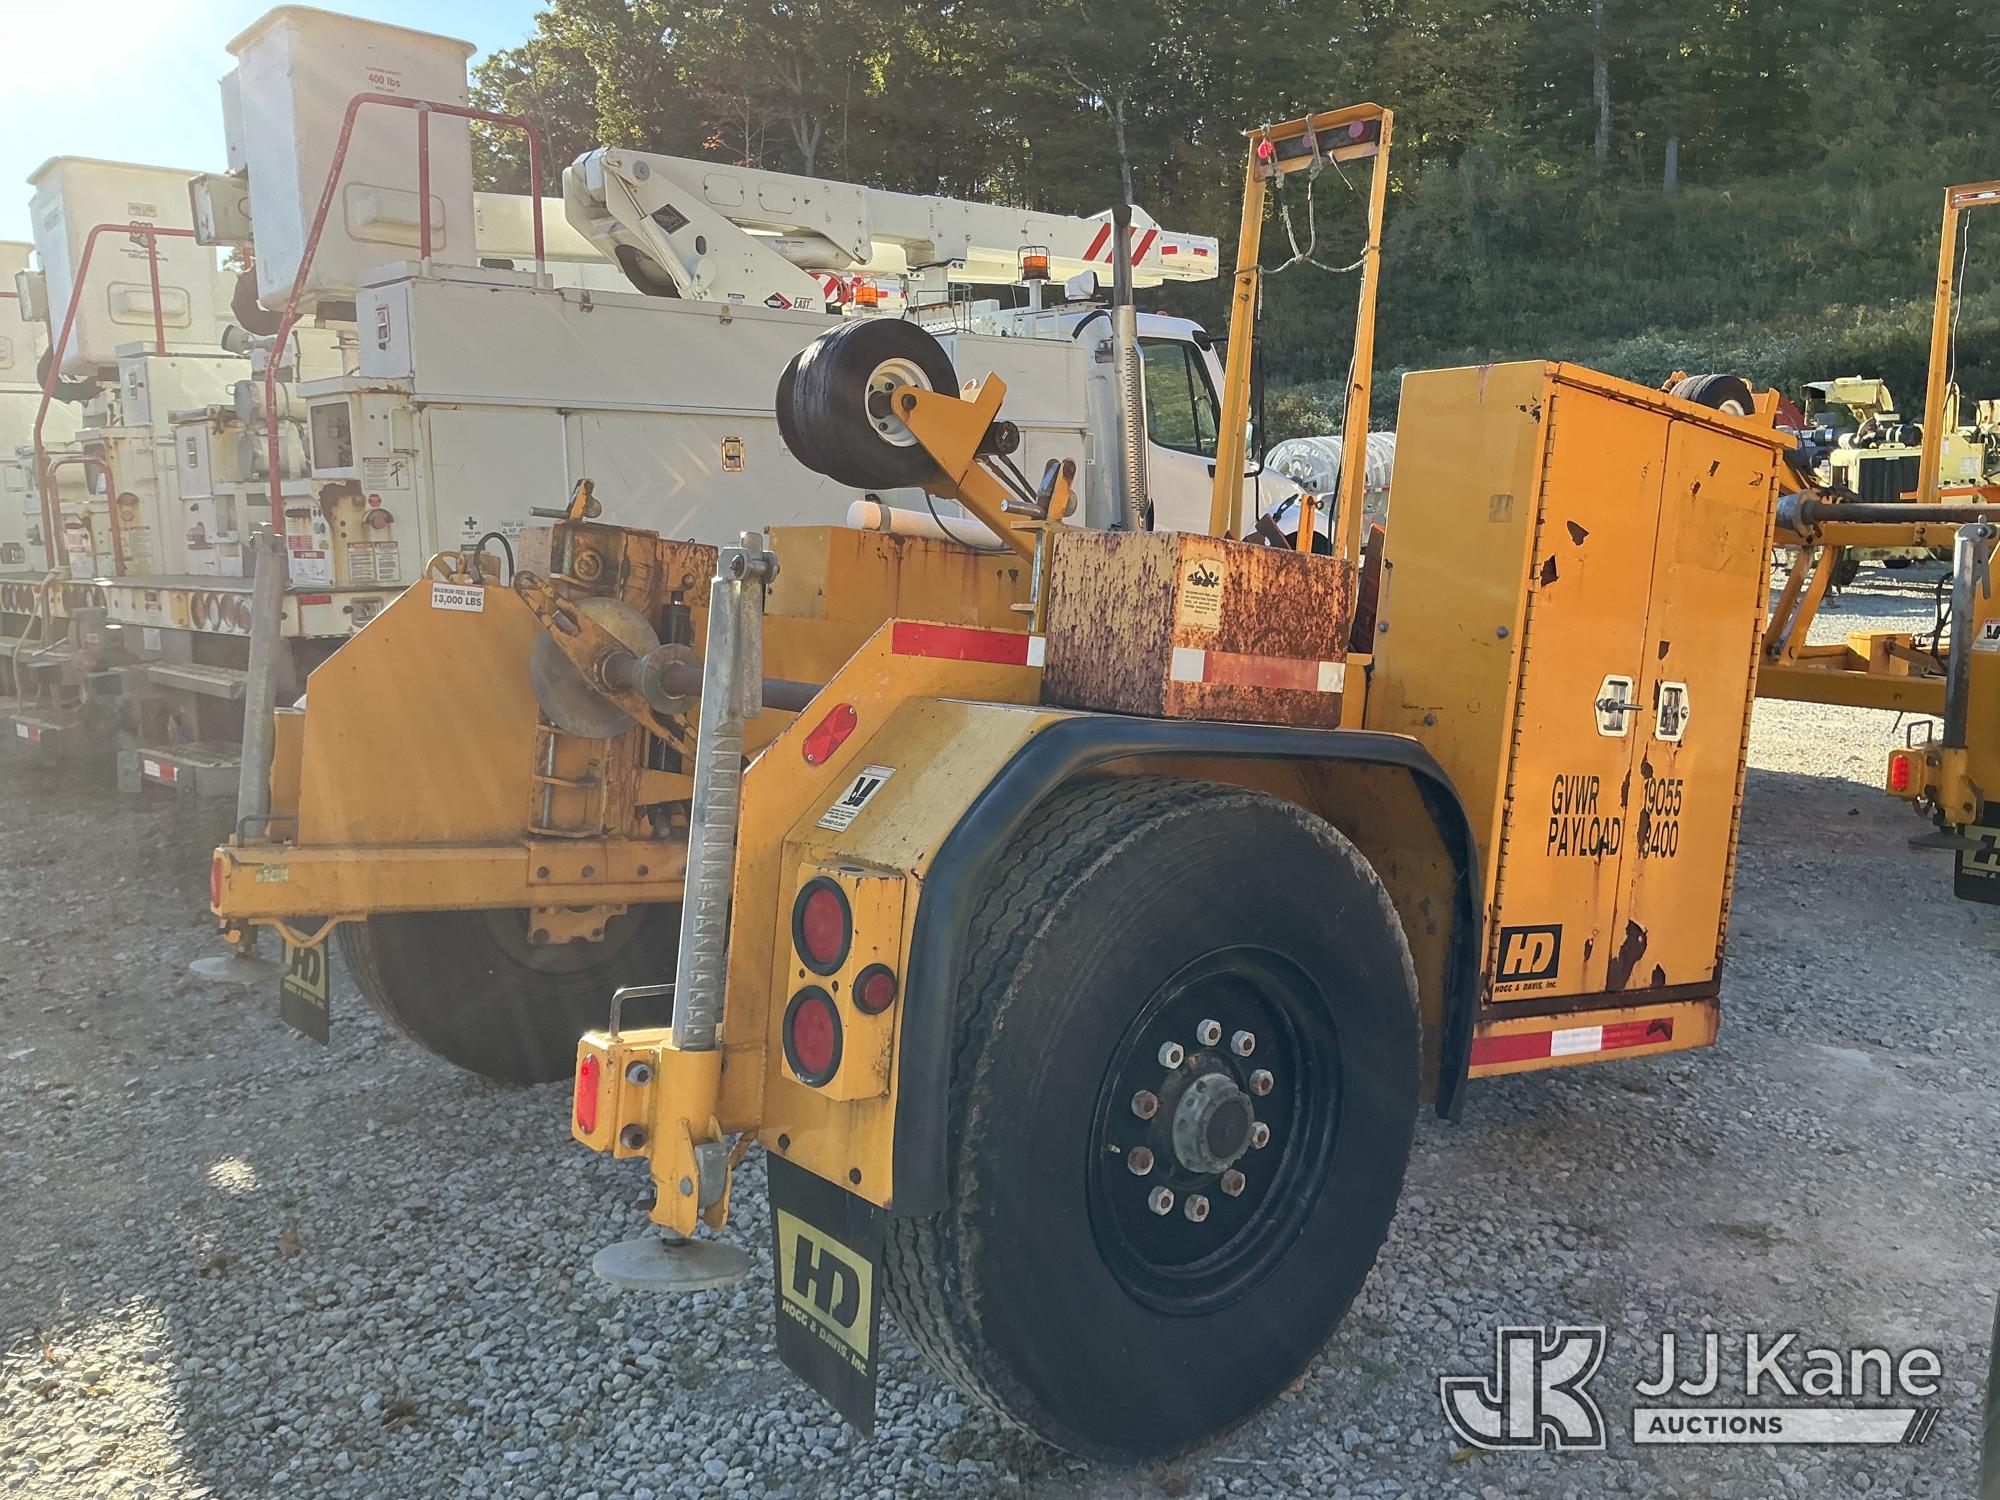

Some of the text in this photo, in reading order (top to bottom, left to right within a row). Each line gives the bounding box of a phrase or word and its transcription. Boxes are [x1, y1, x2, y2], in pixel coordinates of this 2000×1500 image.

[368, 74, 401, 88] 400 lbs
[793, 296, 813, 310] EAST
[434, 594, 482, 607] 13,000 LBS
[1551, 773, 1600, 816] GVWR
[1546, 816, 1621, 857] PAYLOAD
[1502, 932, 1555, 975] HD
[793, 1234, 860, 1328] HD
